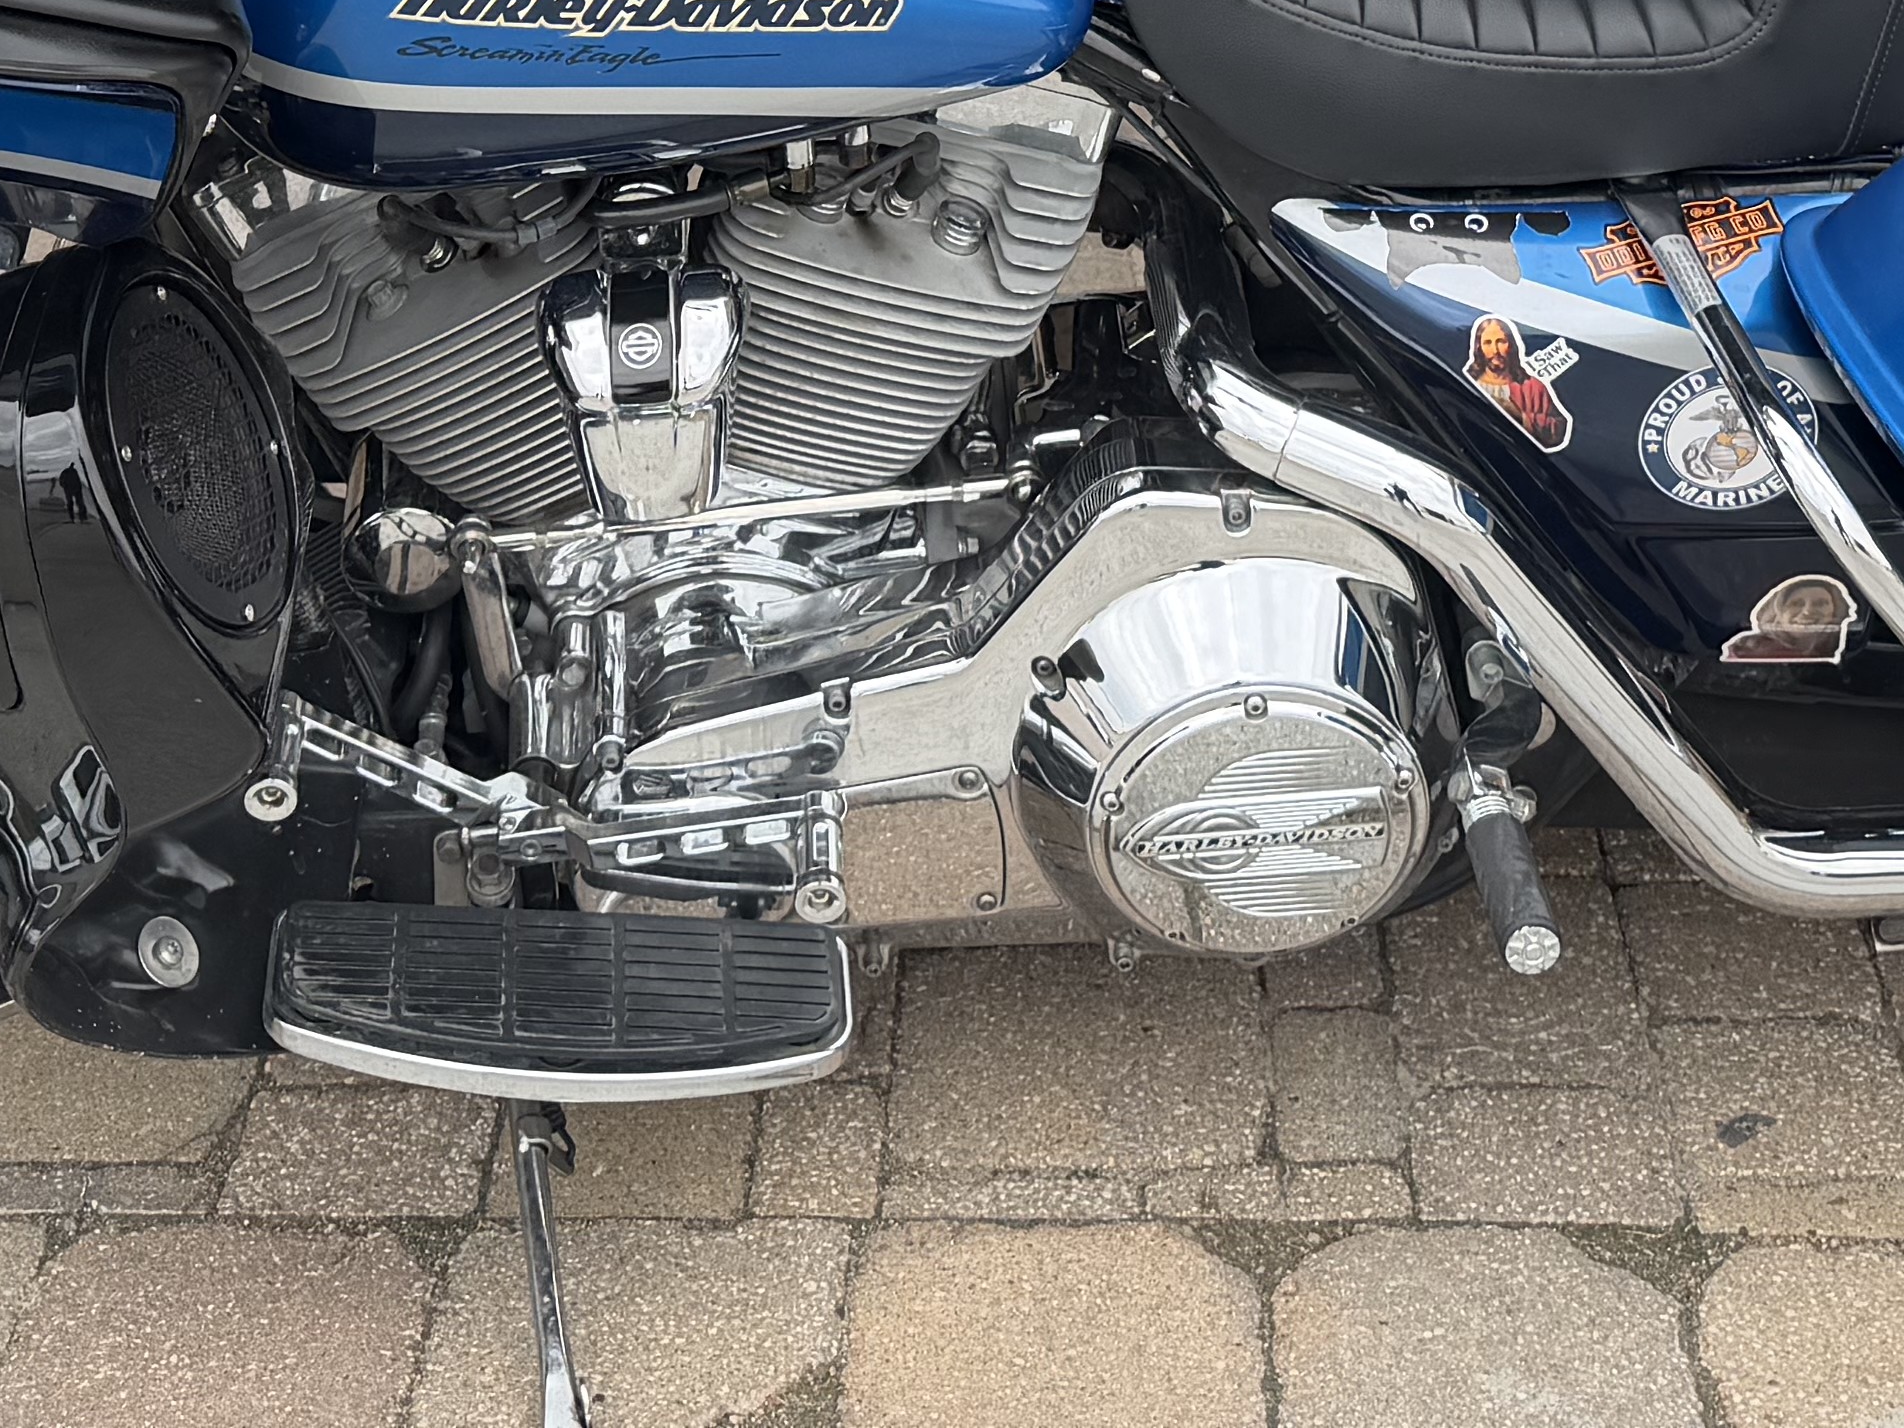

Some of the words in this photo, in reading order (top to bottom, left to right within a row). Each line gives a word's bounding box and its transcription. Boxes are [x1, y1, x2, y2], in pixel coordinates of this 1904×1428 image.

[1534, 340, 1564, 366] Saw
[1537, 352, 1573, 378] That
[1643, 374, 1707, 442] PROUD
[1136, 822, 1386, 857] HARLEY-DAVIDSON
